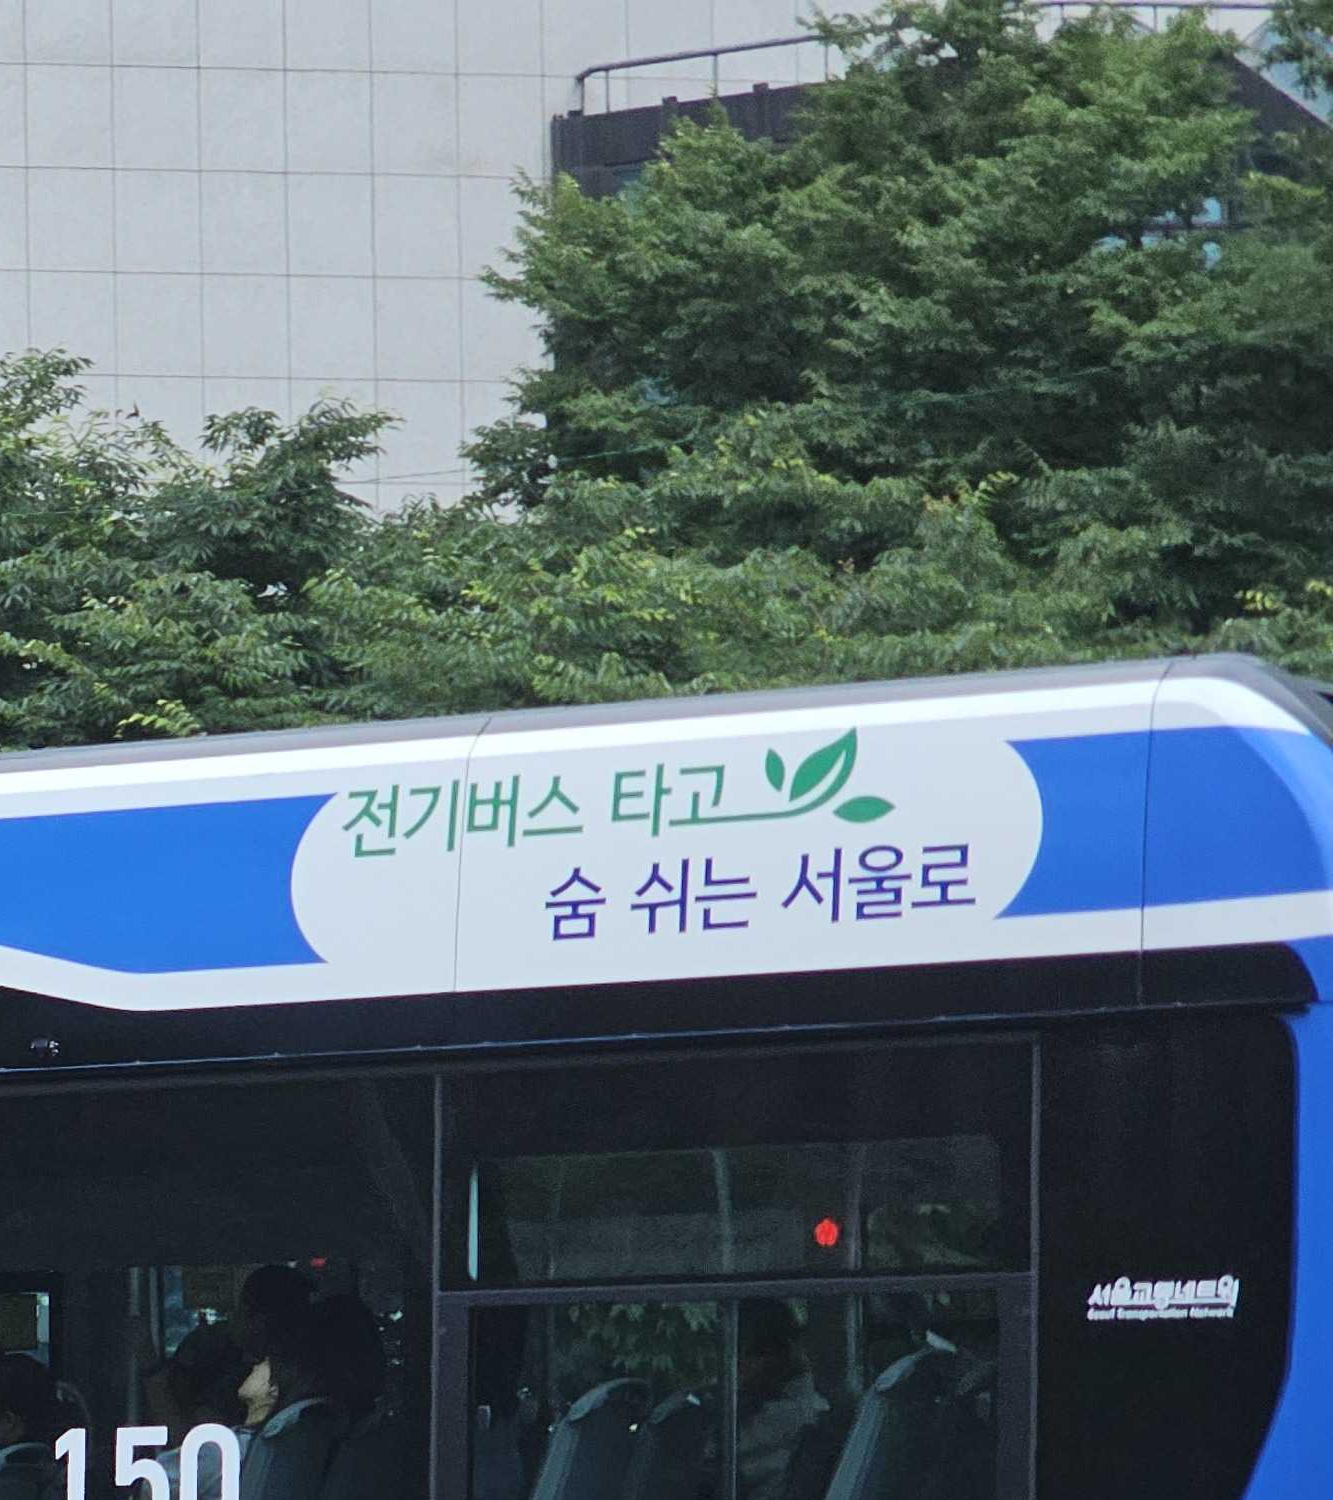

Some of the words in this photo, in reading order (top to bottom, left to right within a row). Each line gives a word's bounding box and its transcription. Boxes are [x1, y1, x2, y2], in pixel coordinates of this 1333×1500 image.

[342, 774, 583, 858] 전기버스
[611, 763, 726, 837] 타고
[545, 866, 607, 941] 숨
[630, 857, 758, 934] 쉬는
[780, 844, 977, 923] 서울로
